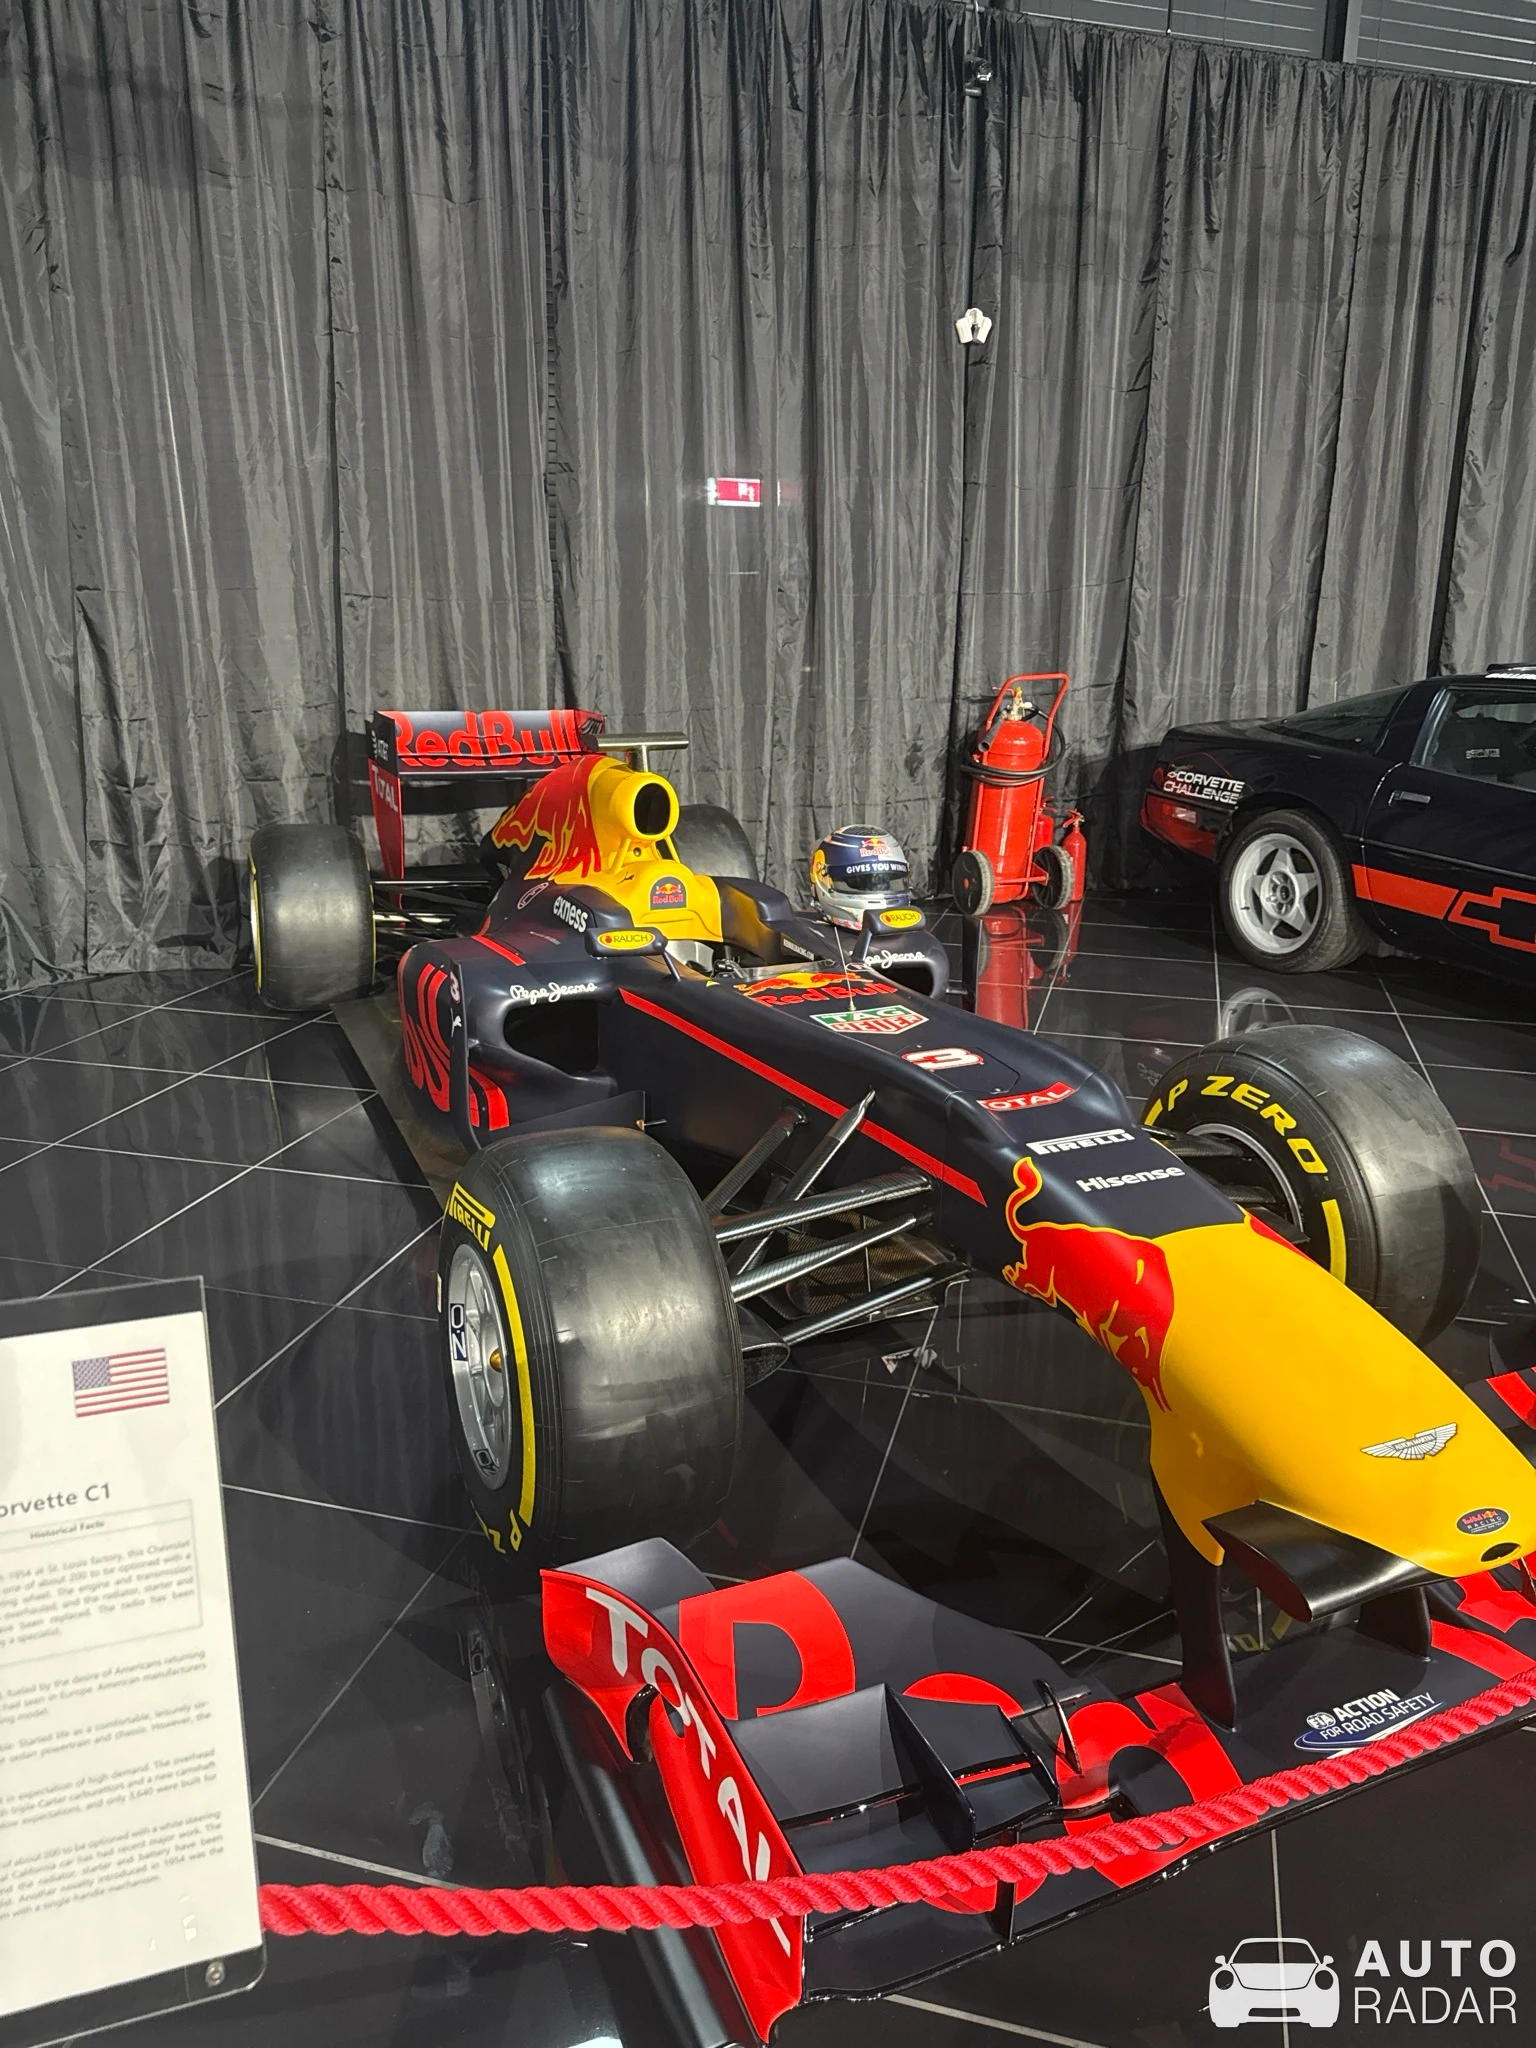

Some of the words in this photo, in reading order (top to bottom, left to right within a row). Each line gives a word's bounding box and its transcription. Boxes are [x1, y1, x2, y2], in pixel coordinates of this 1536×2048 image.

[1163, 781, 1240, 804] CHALLENGE
[1176, 771, 1245, 792] CORVETTE
[846, 864, 871, 874] GIVES
[872, 863, 890, 871] YOU
[653, 895, 669, 904] Red
[669, 894, 683, 904] Bull
[553, 896, 589, 933] exness
[891, 913, 917, 921] RAUCH
[614, 934, 648, 943] RAUCH
[510, 984, 549, 1005] Pepe
[548, 982, 599, 1003] Jeans
[755, 988, 822, 1007] Red
[830, 982, 898, 1000] Bull
[822, 1006, 902, 1023] TAG
[830, 1014, 926, 1032] HEUER
[1167, 1079, 1189, 1112] P
[1200, 1075, 1329, 1174] ZERO
[1026, 1128, 1136, 1156] PIRELLI
[1076, 1166, 1186, 1193] Hisense
[449, 1181, 496, 1252] PIRELLI
[0, 1490, 78, 1517] orvette
[84, 1482, 110, 1503] C1
[1307, 1715, 1334, 1730] FIA
[1332, 1688, 1401, 1722] ACTION
[1320, 1725, 1345, 1740] FOR
[1341, 1712, 1385, 1735] ROAD
[1384, 1692, 1436, 1721] SAFETY
